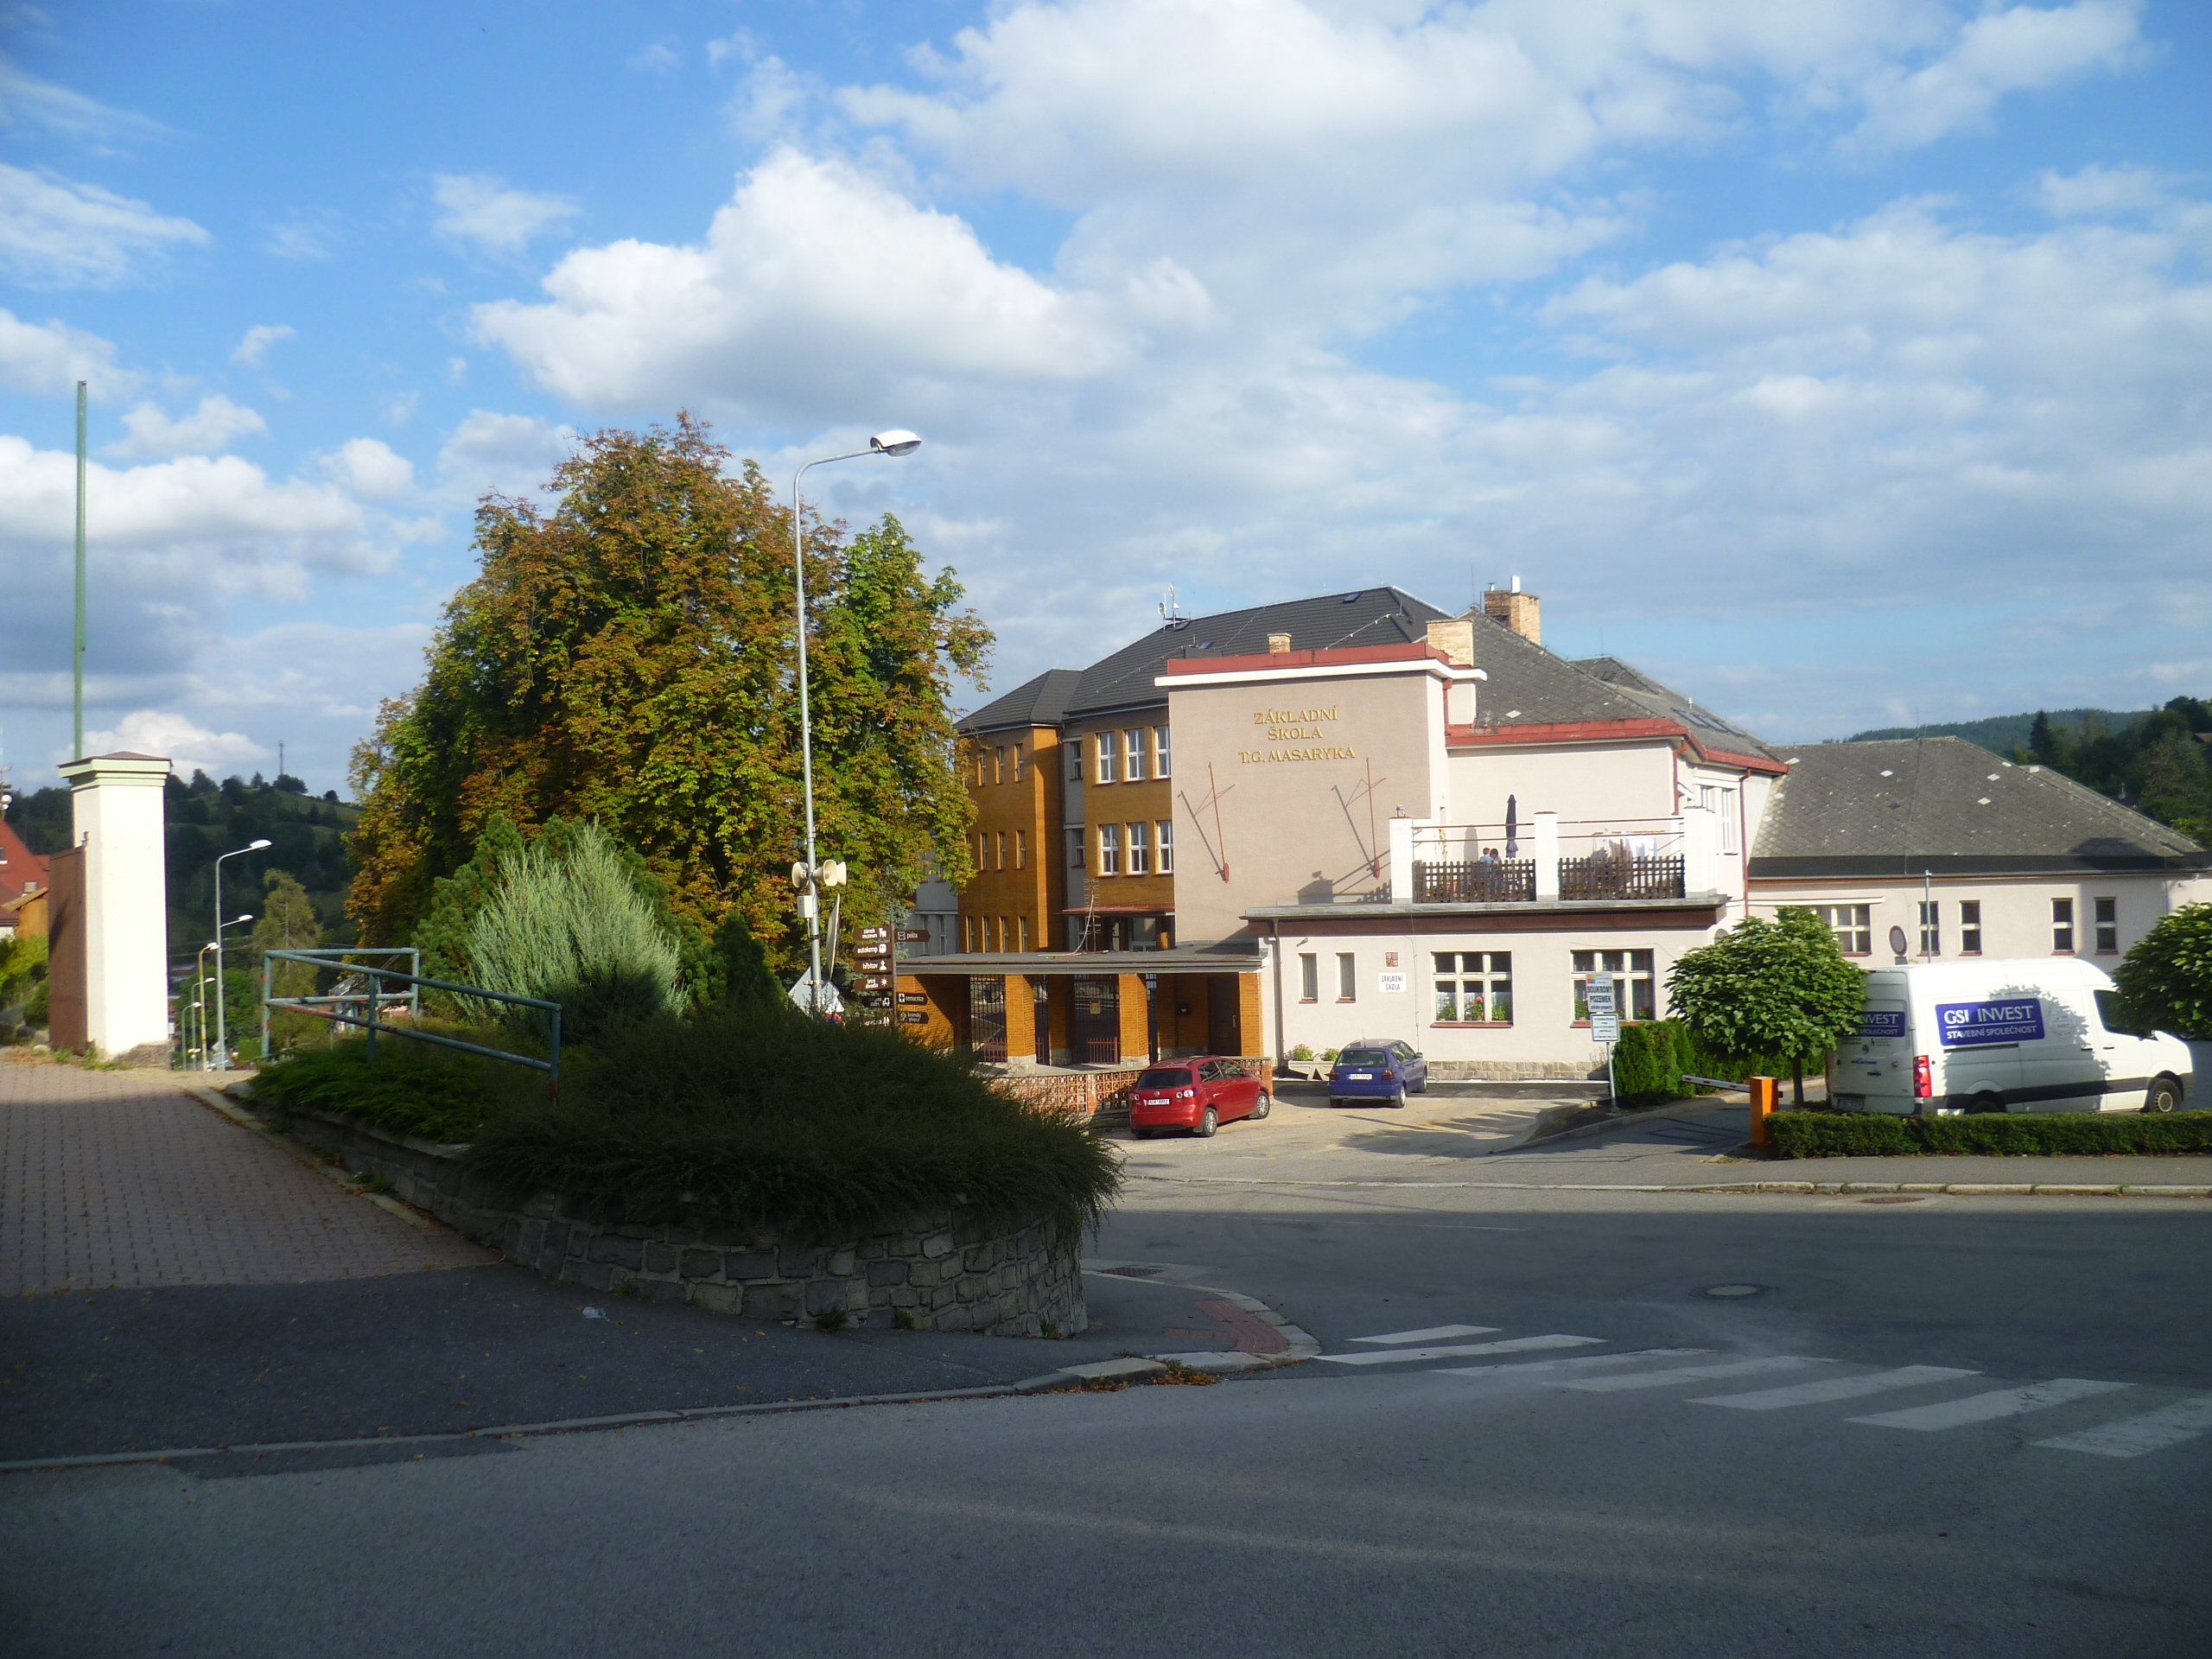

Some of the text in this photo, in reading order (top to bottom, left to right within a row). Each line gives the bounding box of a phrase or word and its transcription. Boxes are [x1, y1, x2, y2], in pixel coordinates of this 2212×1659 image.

[1254, 704, 1338, 725] ZÁKLADNÍ
[1268, 726, 1324, 741] ŠKOLA
[1268, 747, 1356, 762] MASARYKA
[1861, 1014, 1899, 1025] NVEST
[1943, 1008, 1970, 1025] GSI
[1977, 1005, 2034, 1023] INVEST
[1947, 1026, 2037, 1039] STAVEBNÍ SPOLEČNOST
